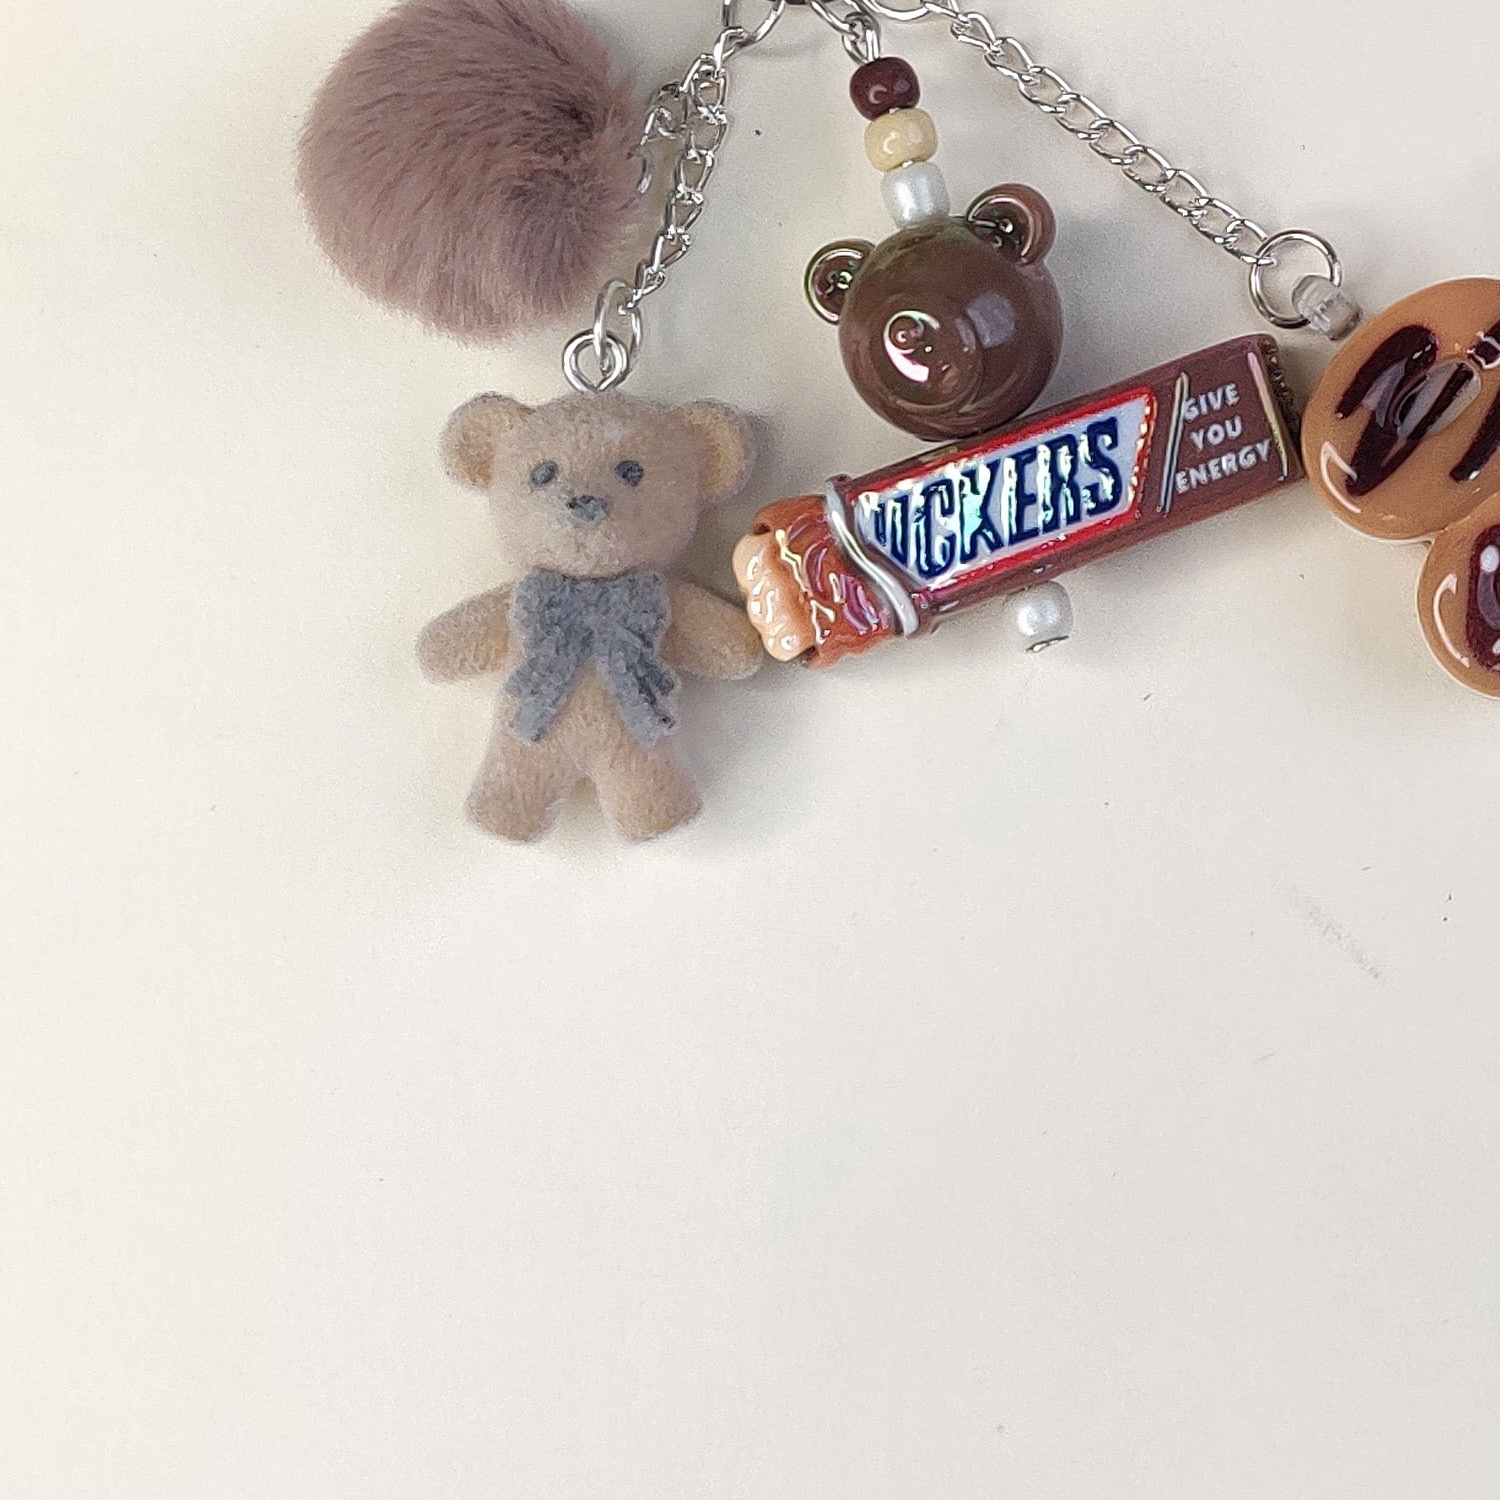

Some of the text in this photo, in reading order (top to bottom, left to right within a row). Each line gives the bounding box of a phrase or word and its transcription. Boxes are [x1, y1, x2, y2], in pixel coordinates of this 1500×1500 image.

[1182, 382, 1240, 422] GIVE
[1190, 415, 1242, 452] YOU
[1174, 438, 1271, 494] ENERGY
